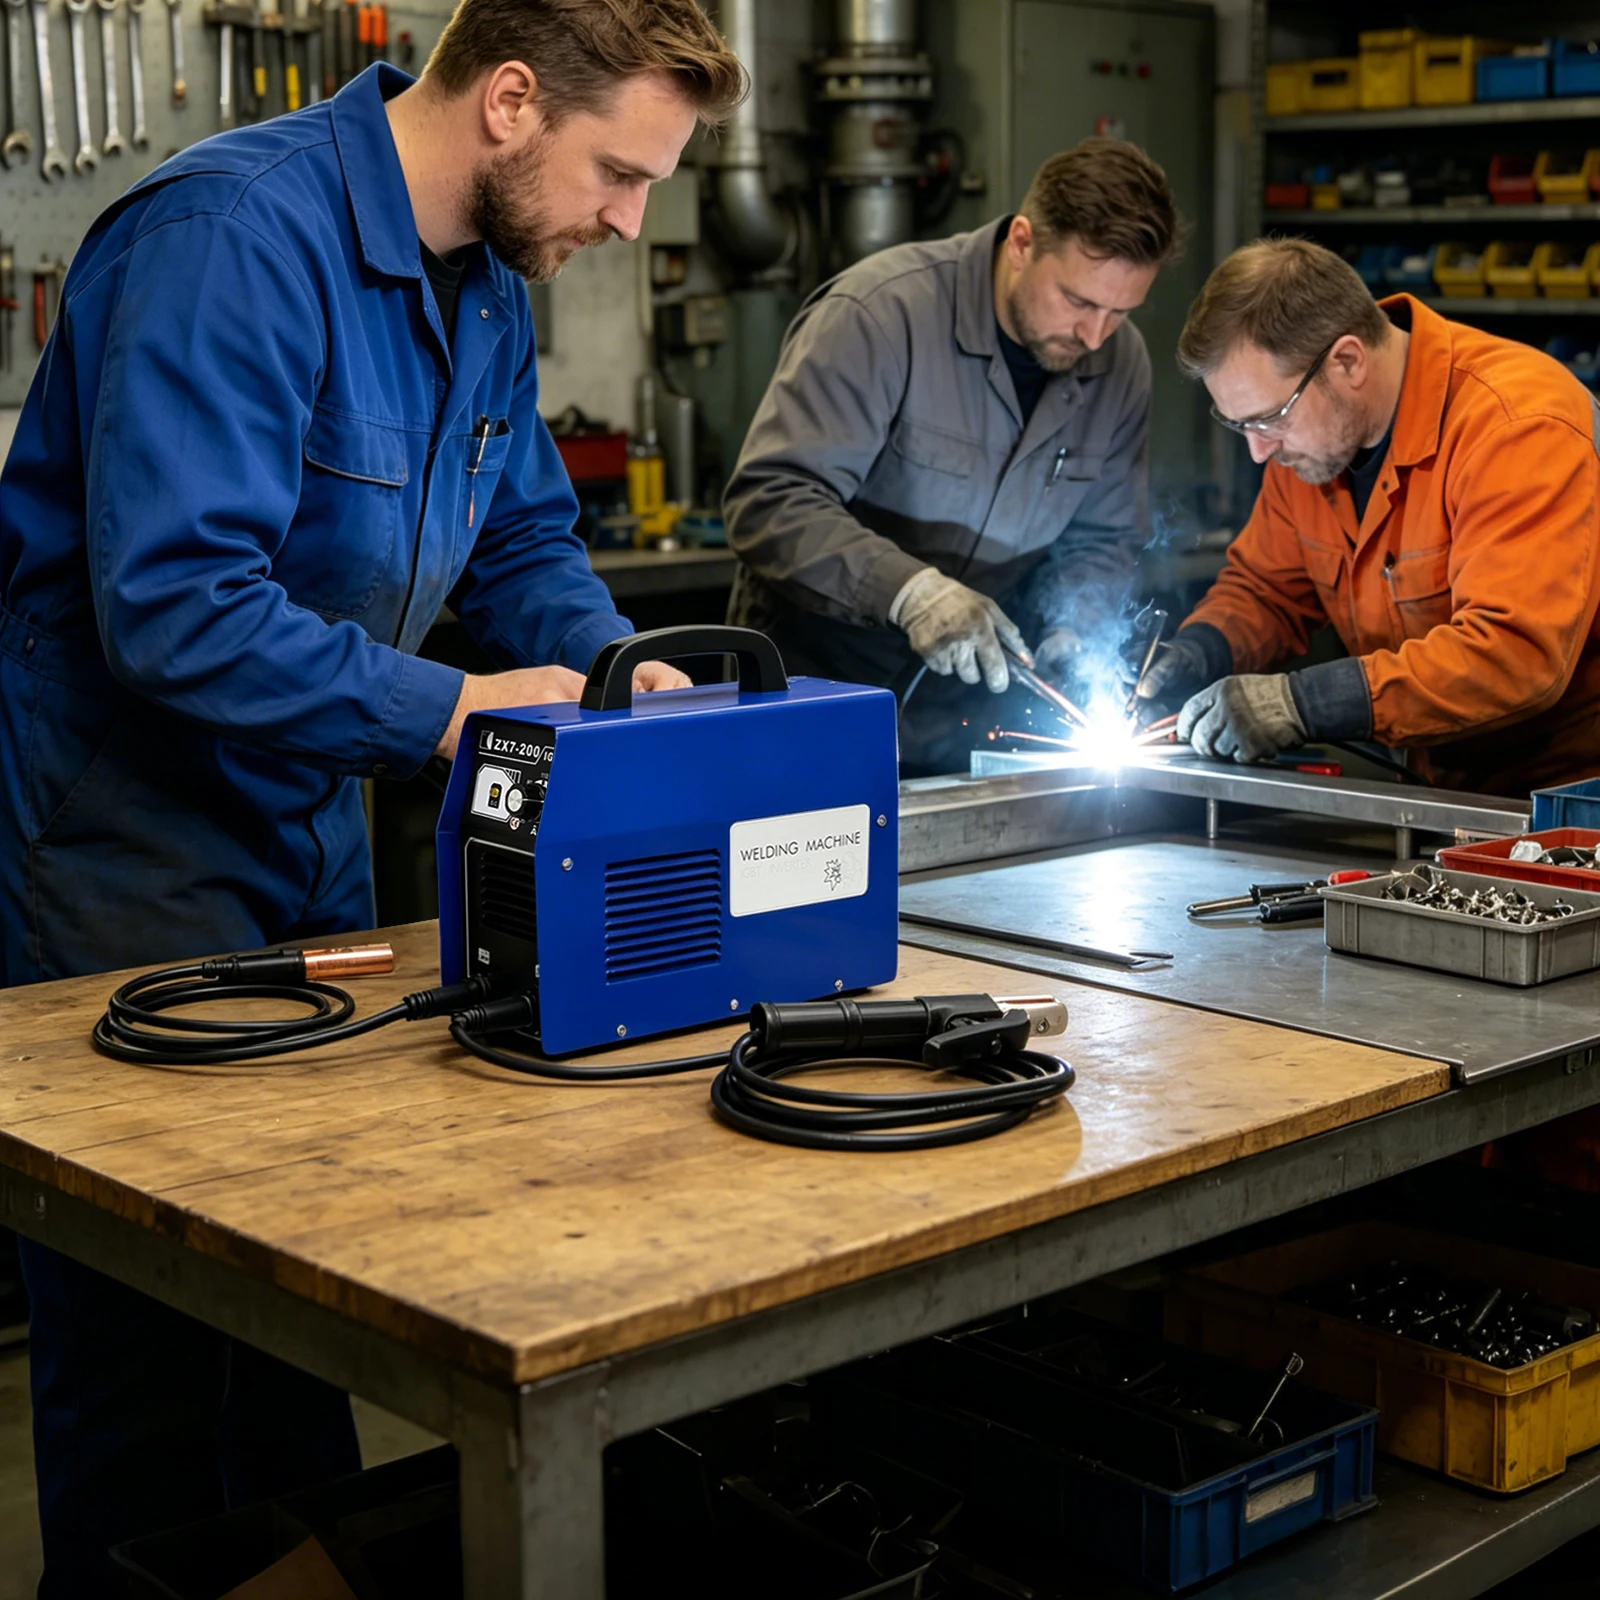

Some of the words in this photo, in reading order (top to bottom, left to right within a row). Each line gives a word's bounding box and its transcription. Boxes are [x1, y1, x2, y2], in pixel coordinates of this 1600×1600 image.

[493, 738, 541, 758] ZX7-200
[740, 841, 799, 861] WELDING
[805, 831, 861, 852] MACHINE
